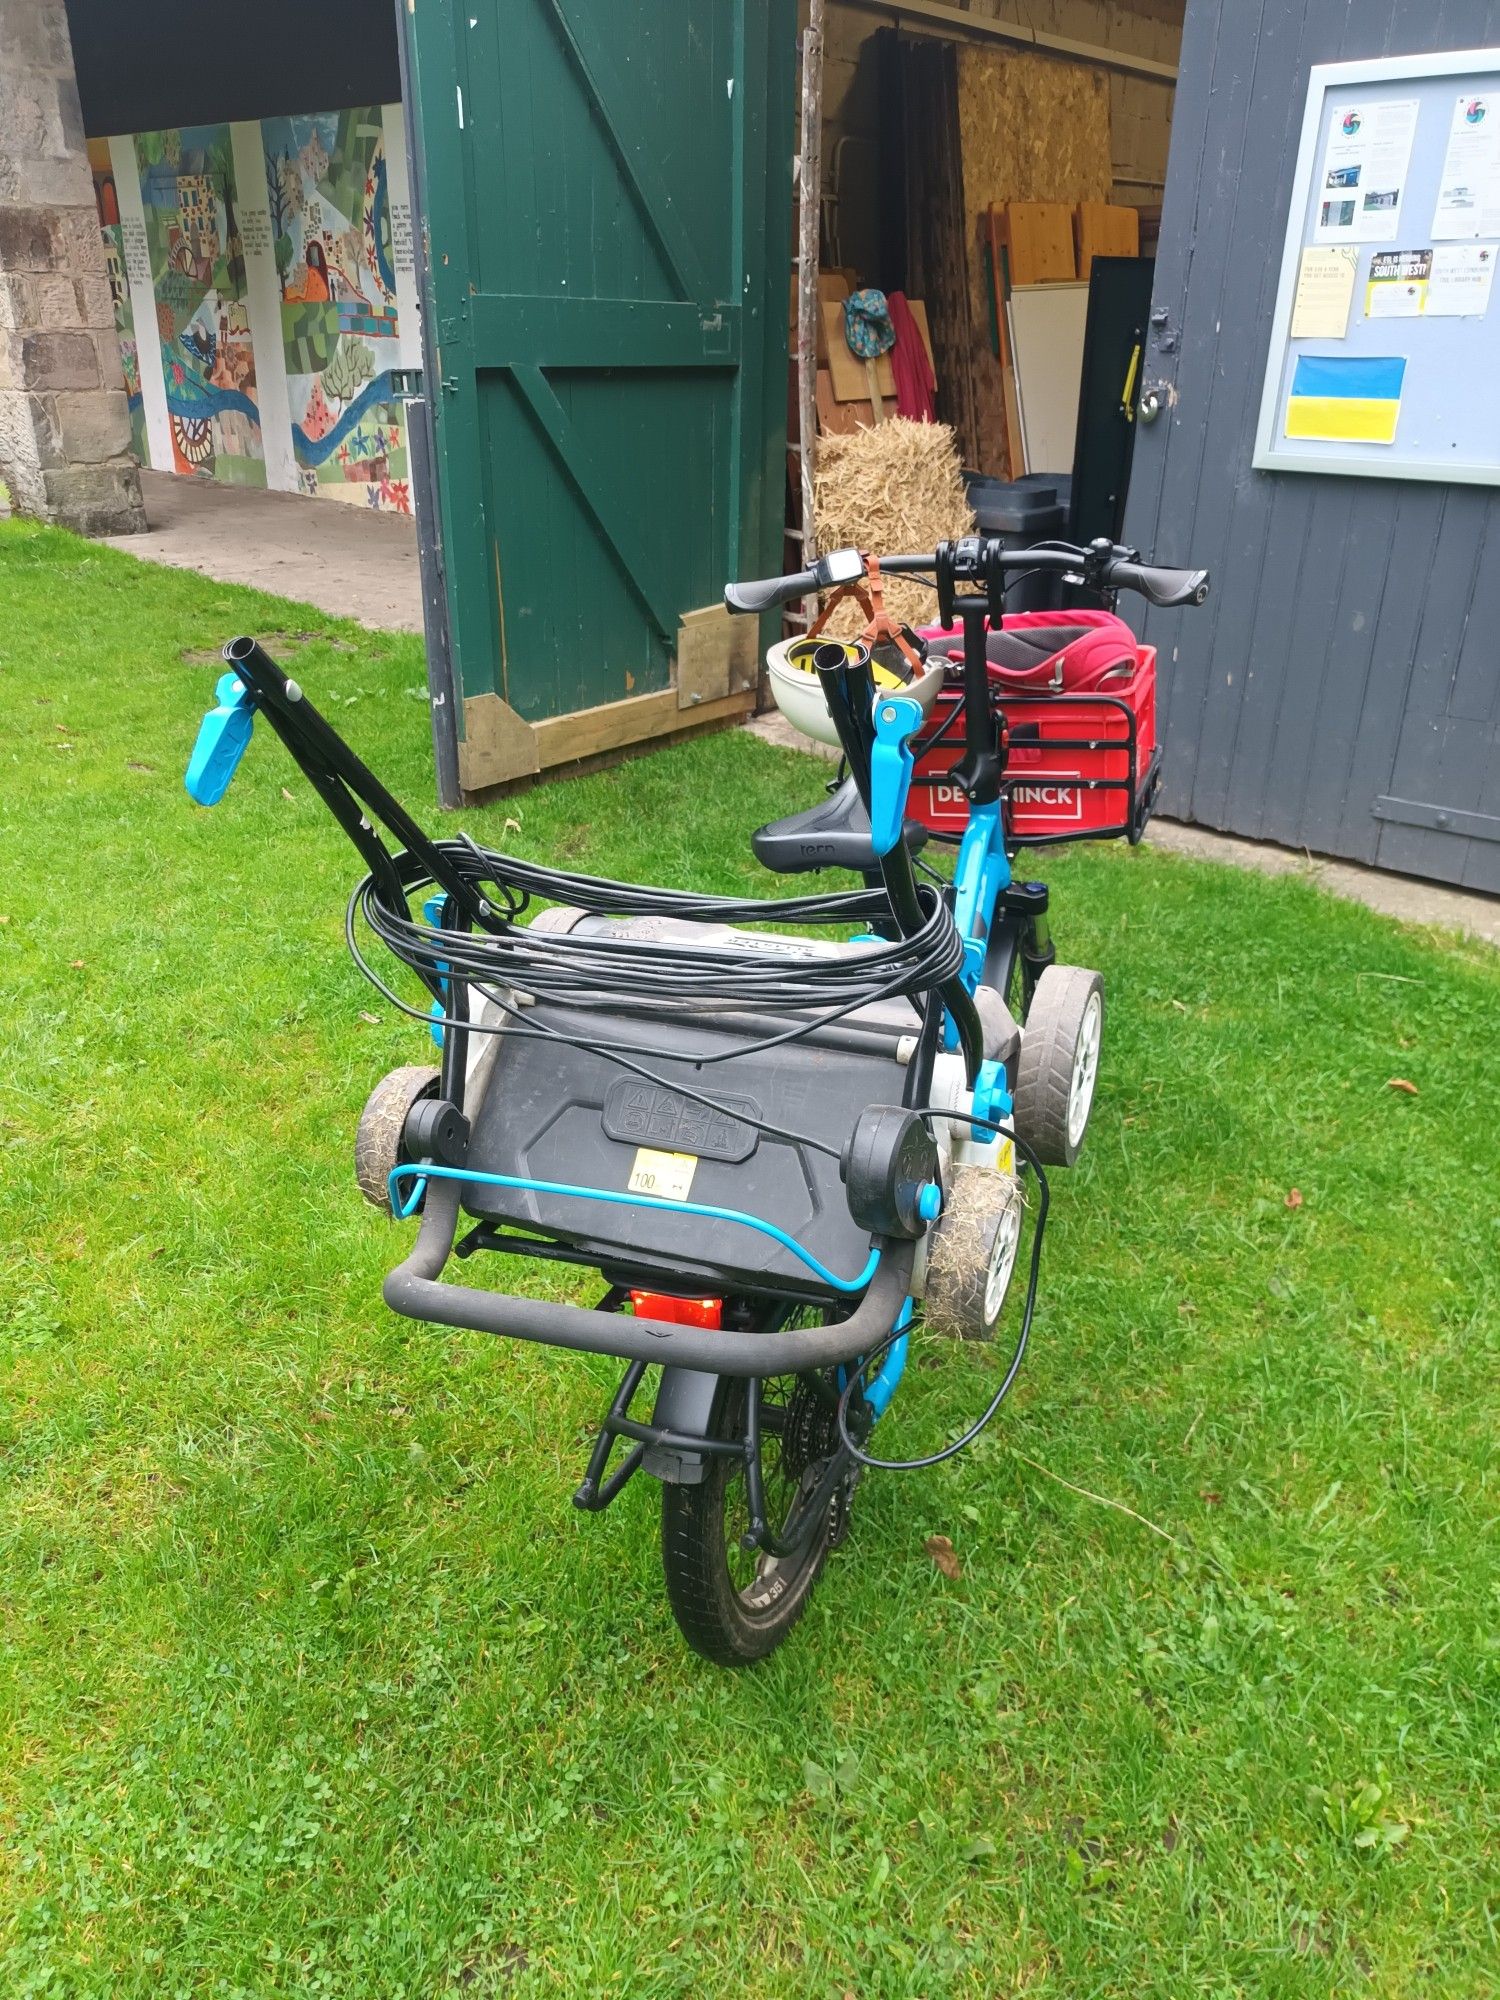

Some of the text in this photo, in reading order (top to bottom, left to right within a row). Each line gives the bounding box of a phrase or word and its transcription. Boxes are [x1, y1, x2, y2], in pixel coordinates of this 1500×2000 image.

[1374, 265, 1400, 277] SOUTH
[937, 785, 965, 803] DE
[799, 844, 836, 857] tern
[634, 1172, 656, 1189] 100
